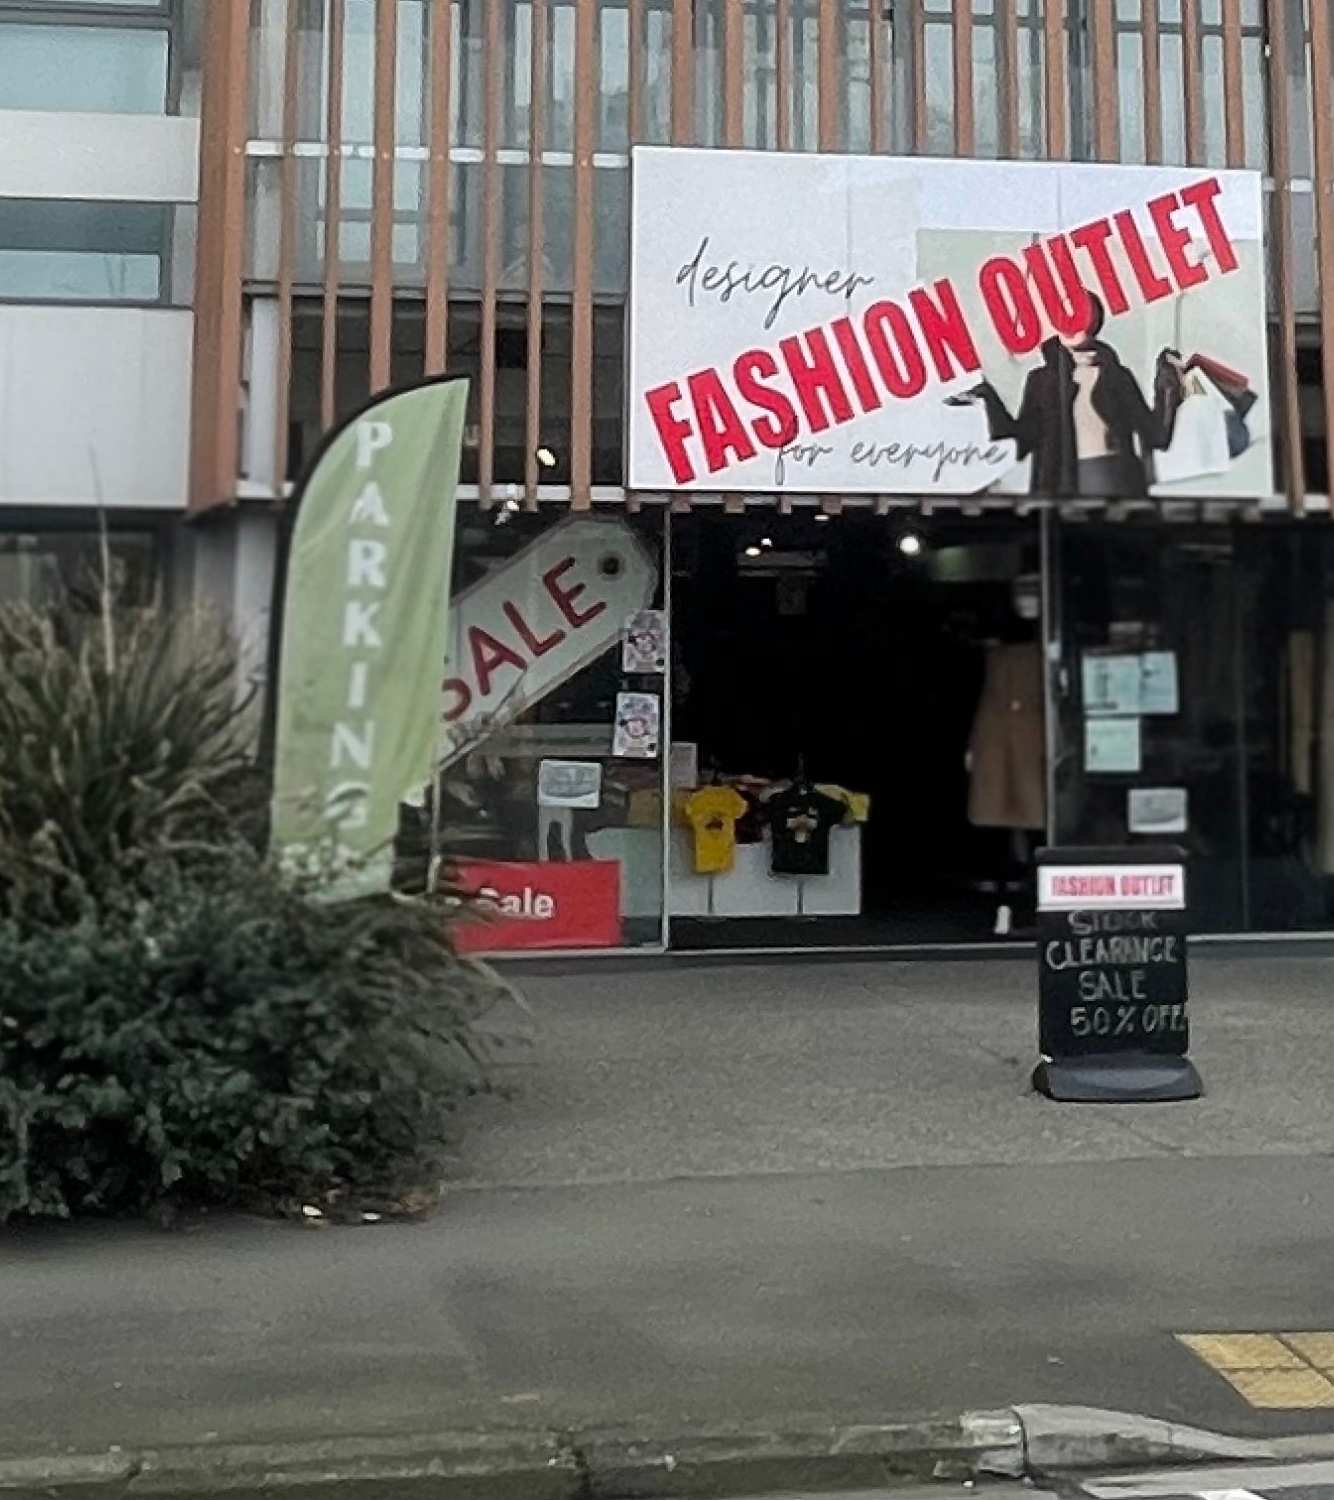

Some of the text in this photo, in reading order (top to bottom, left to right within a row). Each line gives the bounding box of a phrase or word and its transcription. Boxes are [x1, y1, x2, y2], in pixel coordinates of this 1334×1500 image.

[675, 235, 875, 330] designer
[644, 176, 1240, 485] FASHION OUTLET
[773, 437, 1011, 486] for everyone
[324, 419, 395, 829] PARKING
[1051, 875, 1175, 897] FASHION OUTLET
[1067, 910, 1159, 935] STOCK
[1045, 935, 1179, 970] CLEARANCE
[1077, 970, 1149, 1002] SALE
[1070, 1006, 1138, 1037] 50%
